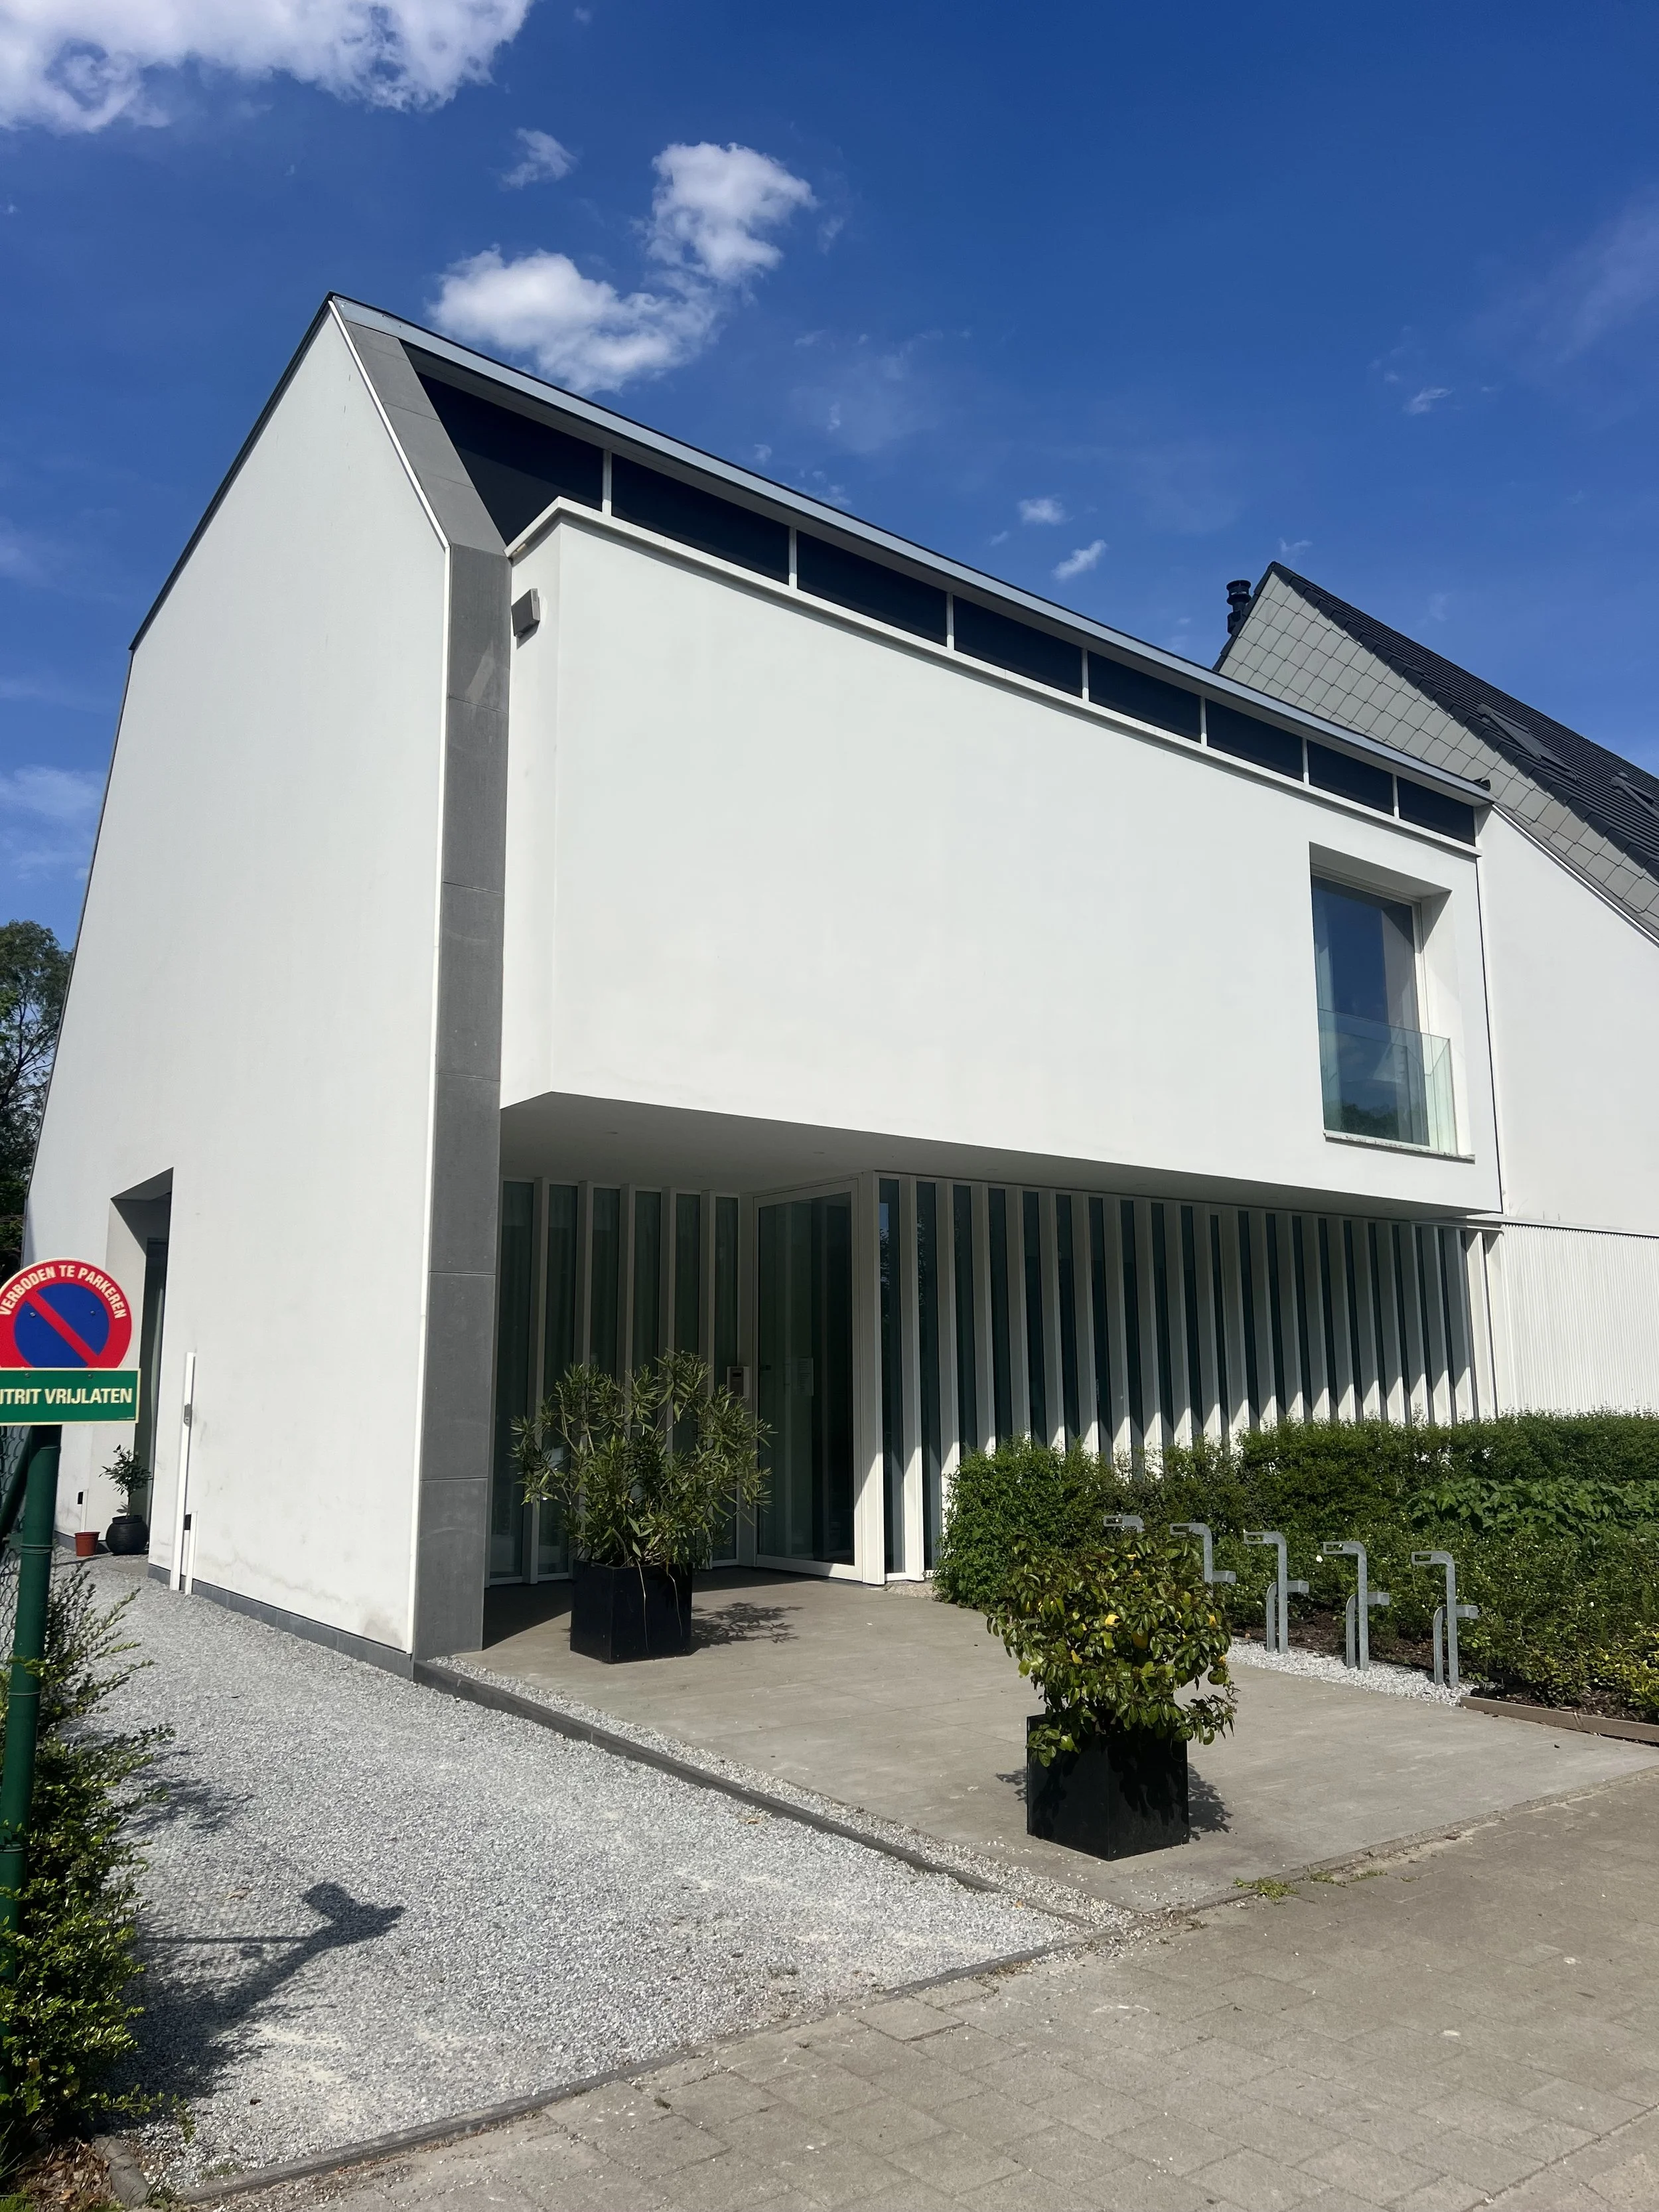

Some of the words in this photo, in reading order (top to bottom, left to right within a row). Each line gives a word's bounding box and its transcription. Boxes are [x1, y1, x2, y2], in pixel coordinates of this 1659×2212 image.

[0, 1266, 56, 1315] VERBODEN
[58, 1265, 76, 1278] TE
[78, 1267, 127, 1319] PARKEREN
[44, 1388, 133, 1404] VRIJLATEN
